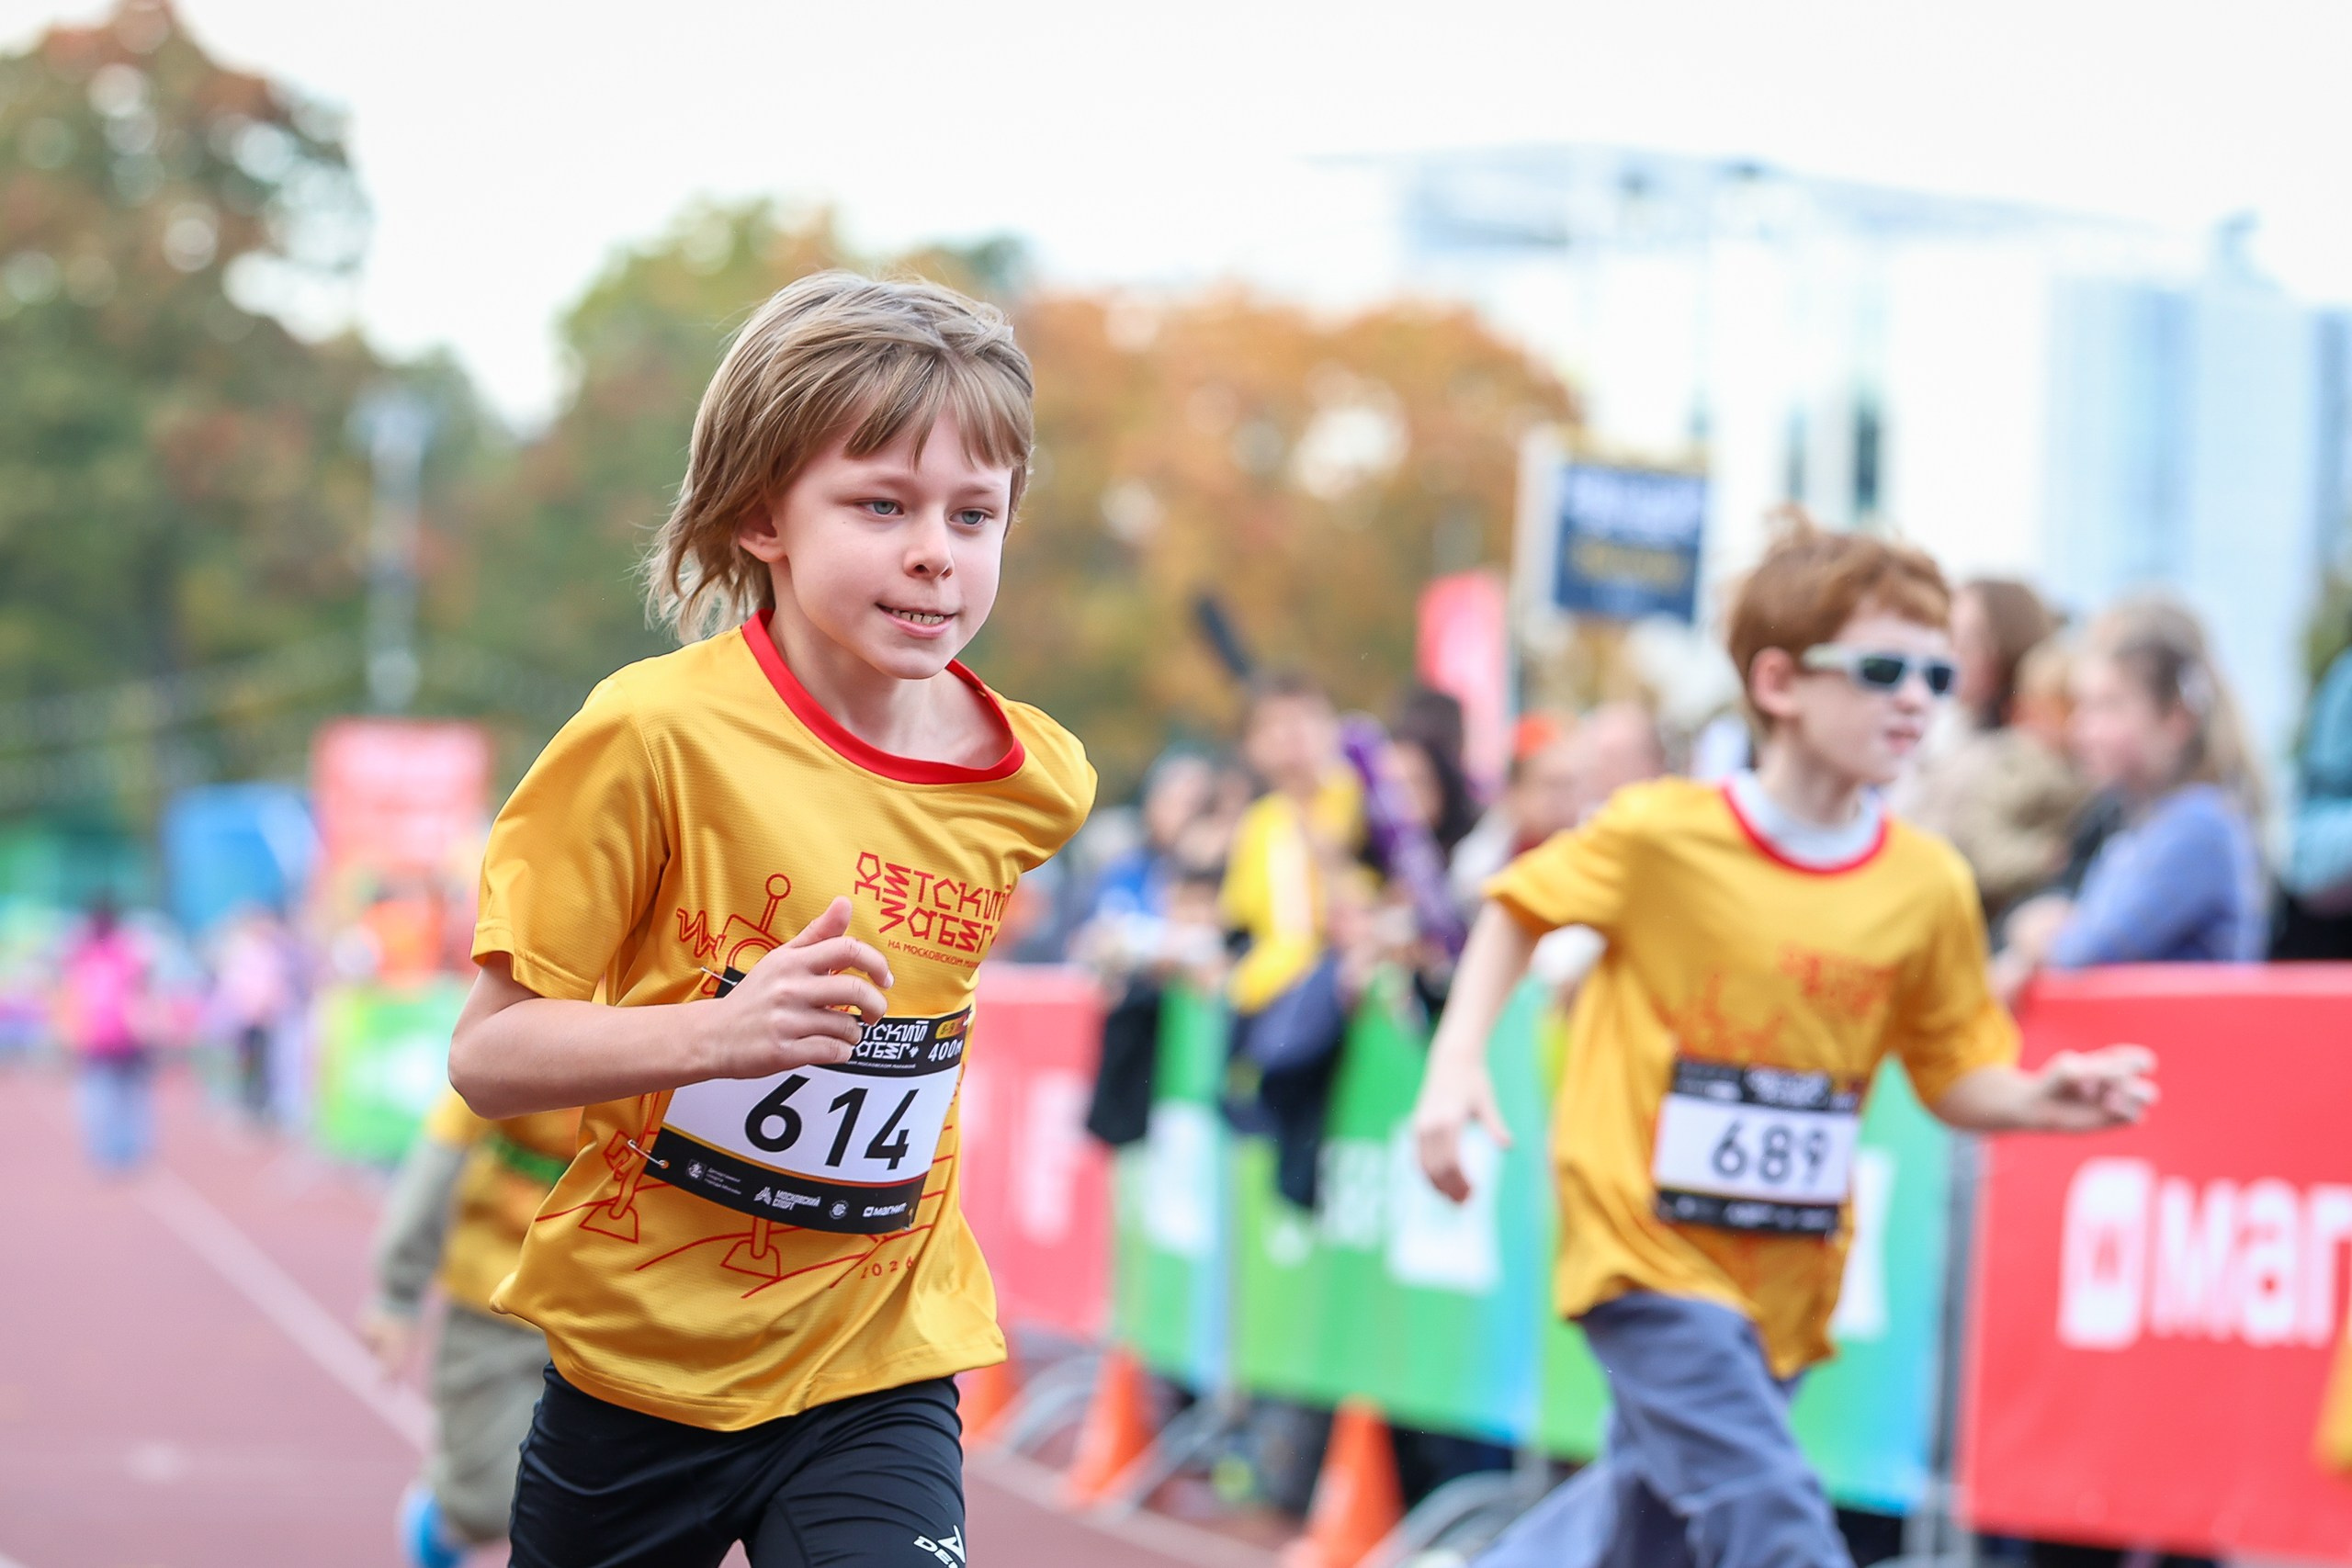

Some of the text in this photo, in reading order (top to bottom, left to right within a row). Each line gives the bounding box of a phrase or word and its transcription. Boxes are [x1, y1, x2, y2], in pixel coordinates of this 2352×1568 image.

[888, 939, 901, 951] НА
[903, 943, 964, 965] МОСКОВСКОМ
[744, 1073, 920, 1170] 614
[1710, 1117, 1831, 1187] 689
